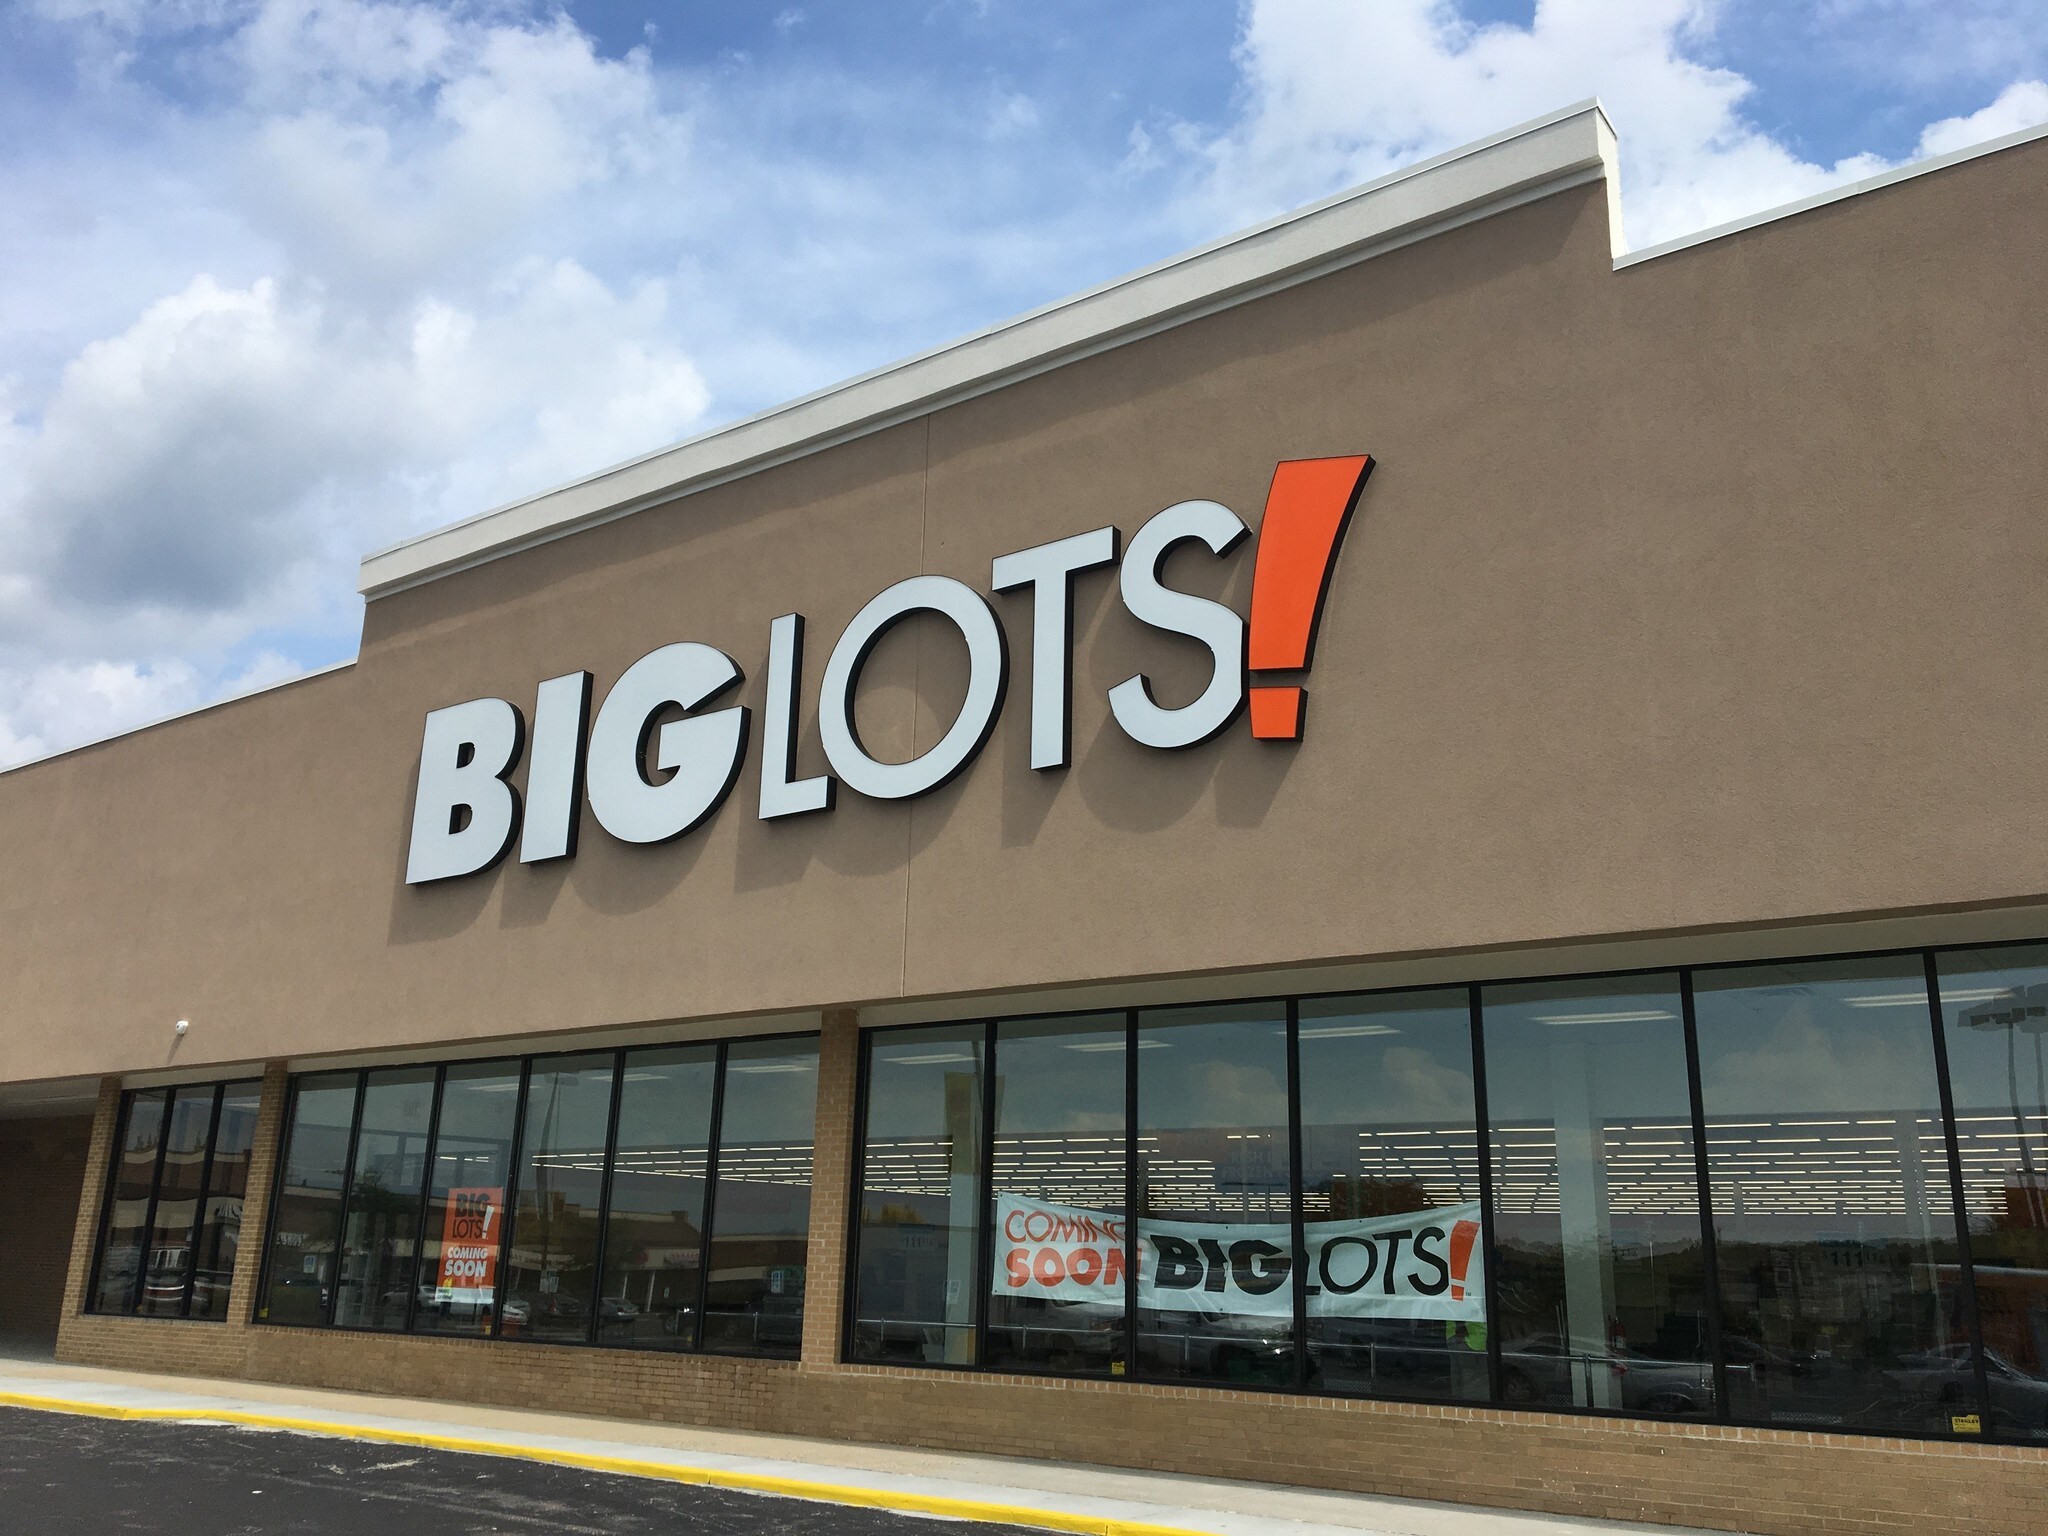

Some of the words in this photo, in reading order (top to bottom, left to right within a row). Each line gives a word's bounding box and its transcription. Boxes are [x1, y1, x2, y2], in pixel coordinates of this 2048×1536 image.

[454, 1193, 491, 1218] BIG
[452, 1205, 495, 1240] LOTS!
[447, 1246, 488, 1259] COMING
[444, 1260, 487, 1277] SOON
